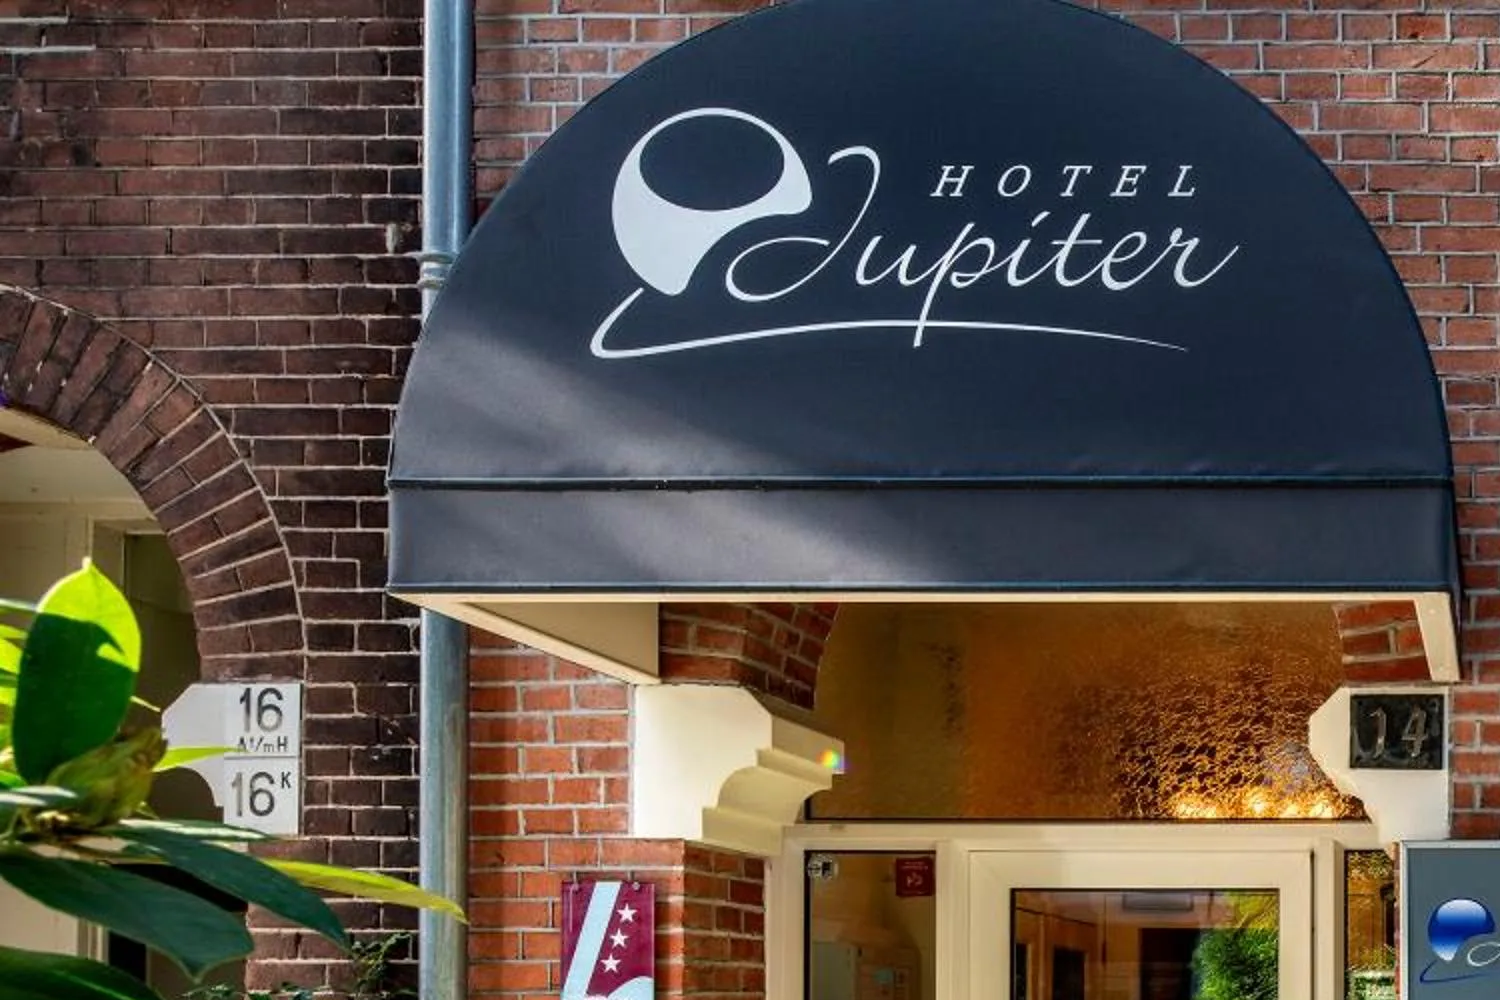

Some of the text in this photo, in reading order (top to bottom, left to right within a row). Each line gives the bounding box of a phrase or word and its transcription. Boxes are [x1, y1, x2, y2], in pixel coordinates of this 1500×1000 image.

[930, 164, 1197, 198] HOTEL
[725, 144, 1239, 348] Jupiter
[239, 687, 284, 733] 16
[1368, 704, 1429, 759] 14
